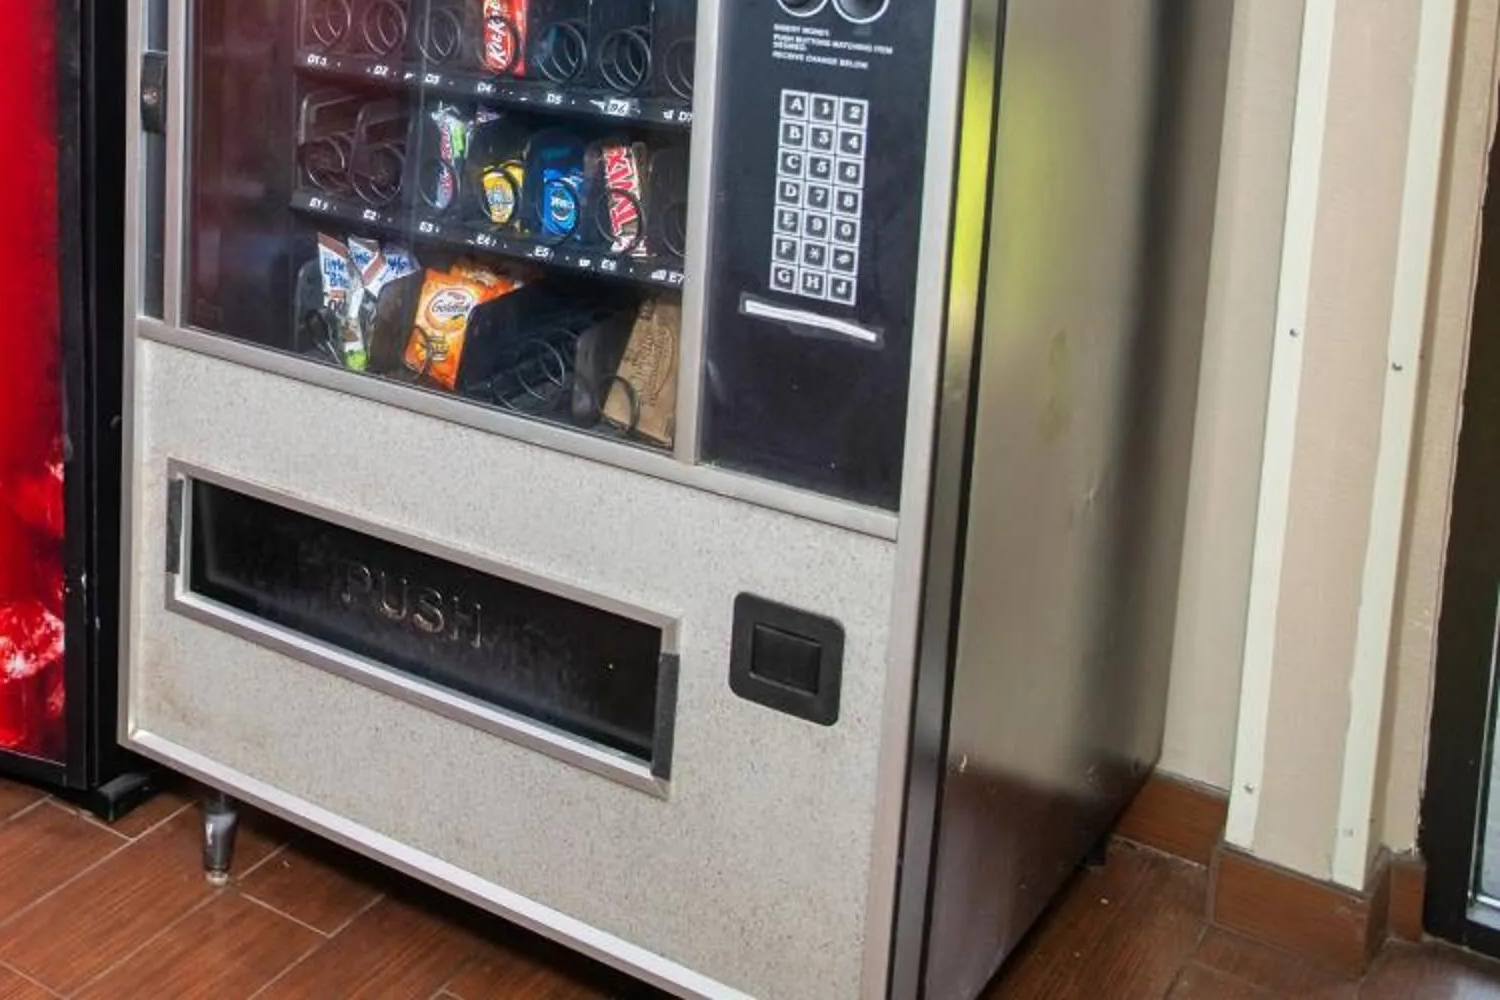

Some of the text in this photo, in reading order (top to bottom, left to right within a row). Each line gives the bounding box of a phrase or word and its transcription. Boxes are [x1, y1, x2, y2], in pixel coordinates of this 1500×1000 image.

[790, 97, 861, 119] A 1 2
[788, 126, 859, 149] B 3 4
[786, 156, 857, 178] C 5 6
[603, 146, 641, 238] TWIX
[785, 185, 854, 208] D 7 8
[777, 270, 847, 294] G H J
[343, 564, 483, 649] PUSH
